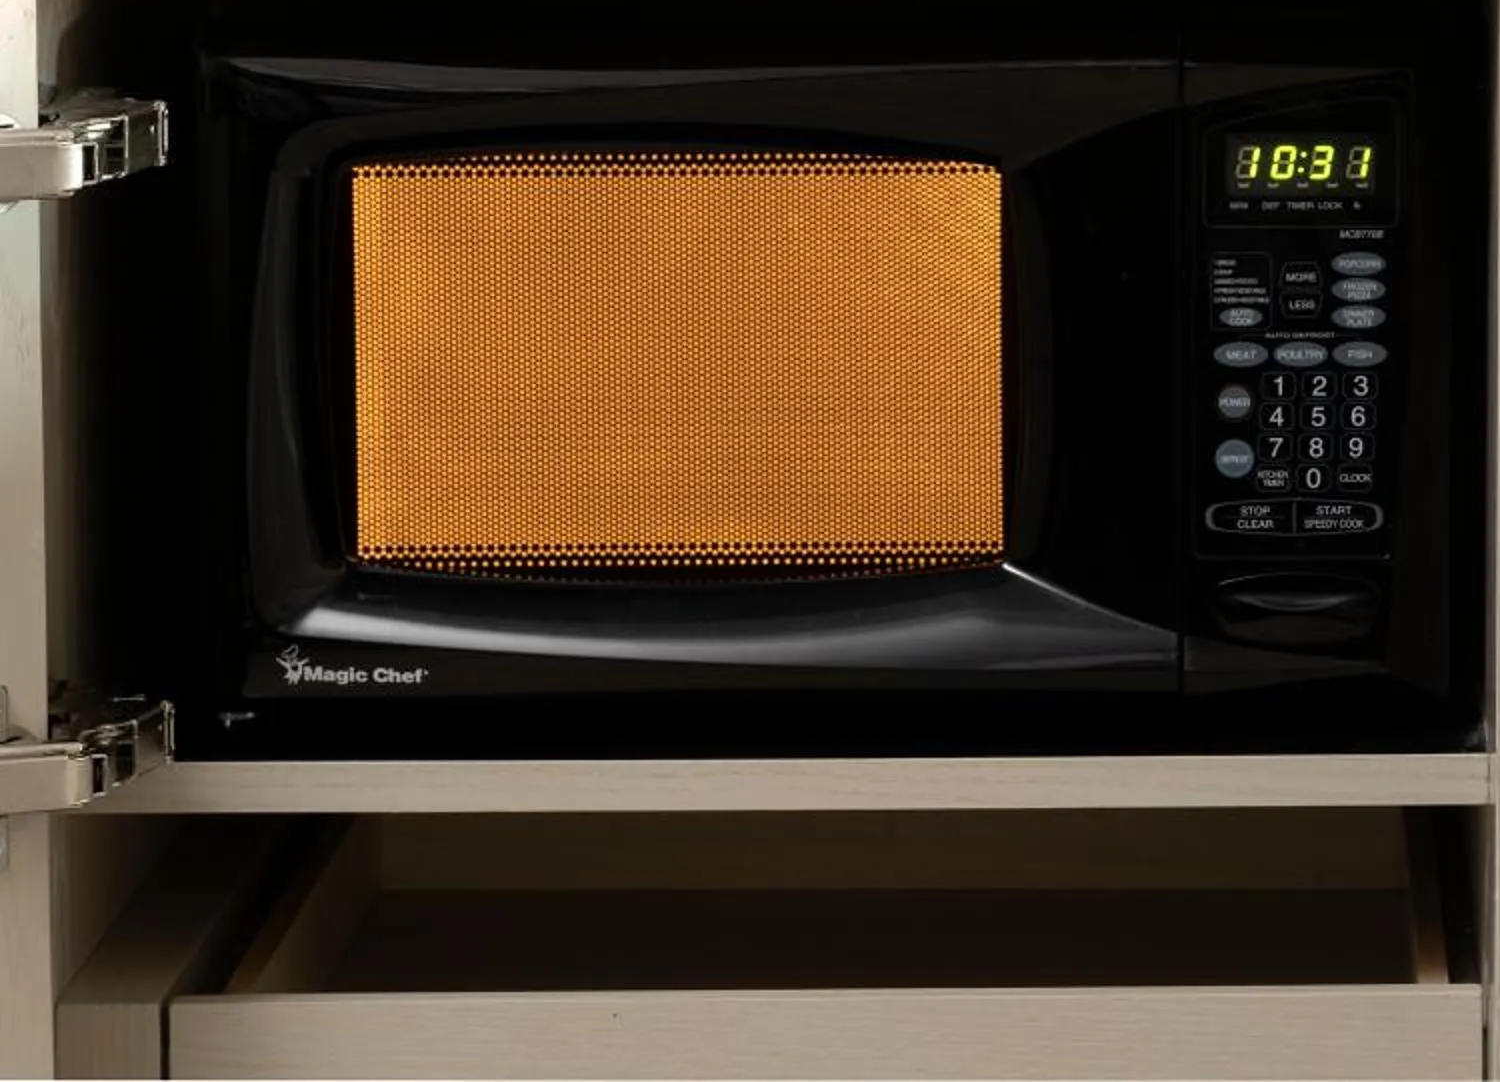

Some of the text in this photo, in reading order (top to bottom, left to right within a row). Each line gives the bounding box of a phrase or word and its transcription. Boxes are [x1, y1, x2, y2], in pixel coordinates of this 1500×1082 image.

[1249, 144, 1372, 181] 10:31
[1317, 201, 1343, 210] LOCK
[1285, 271, 1317, 282] MORE
[1289, 299, 1315, 310] LESS
[1225, 349, 1258, 360] MEAT
[1277, 349, 1325, 360] POULTRY
[1347, 349, 1373, 359] FISH
[1274, 375, 1284, 396] 1
[1311, 375, 1328, 397] 2
[1352, 375, 1369, 397] 3
[1269, 406, 1285, 427] 4
[1311, 406, 1326, 427] 5
[1350, 406, 1367, 427] 6
[1268, 437, 1284, 458] 7
[1309, 437, 1324, 459] 8
[1349, 437, 1364, 459] 9
[1305, 468, 1321, 489] 0
[1339, 473, 1373, 483] CLOCK
[1240, 505, 1271, 517] STOP
[1315, 505, 1352, 516] START
[1237, 519, 1274, 529] CLEAR
[1304, 519, 1364, 529] SPEEDY COOK
[303, 666, 423, 685] Magic Chef
